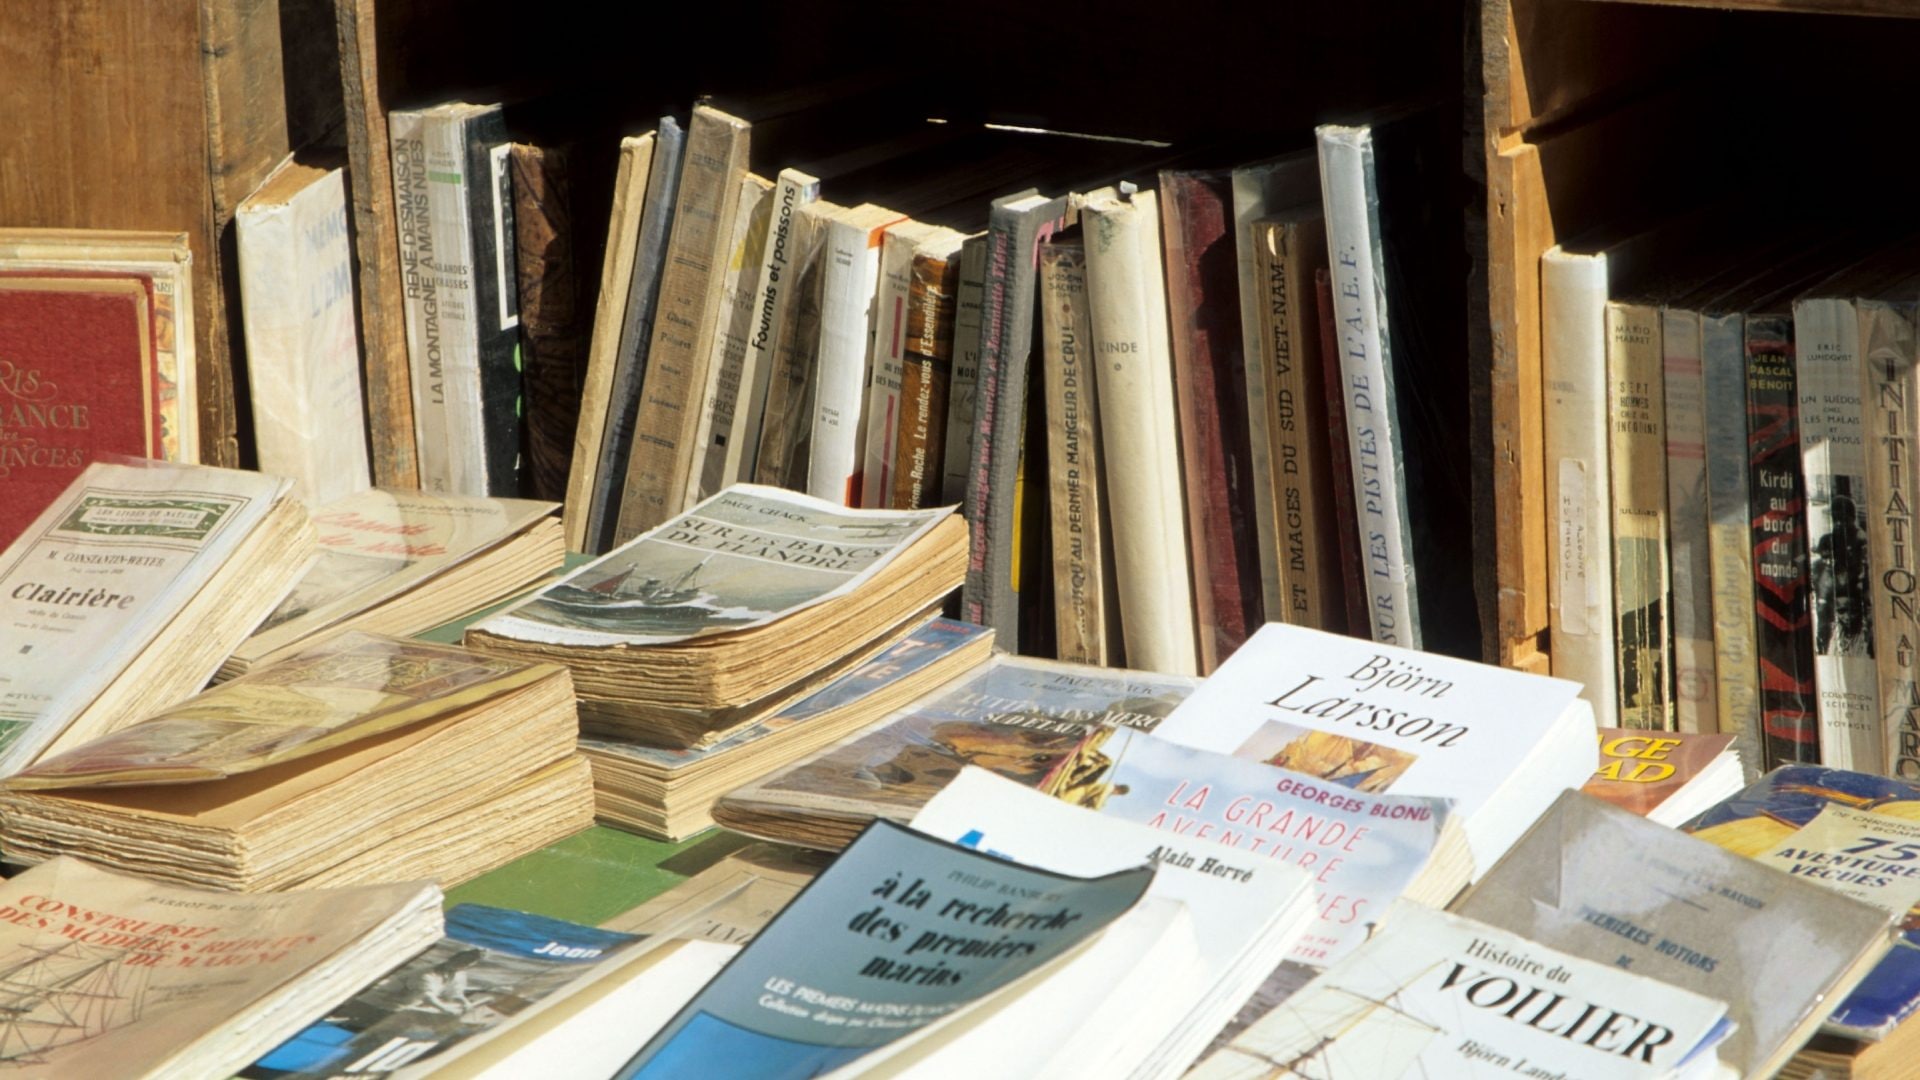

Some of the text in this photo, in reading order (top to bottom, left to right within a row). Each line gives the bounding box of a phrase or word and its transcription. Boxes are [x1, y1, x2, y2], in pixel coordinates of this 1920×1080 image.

[394, 138, 417, 247] DESMAISON
[409, 139, 444, 405] LA MONTAGNE A MAINS NUES
[434, 263, 468, 275] GRANDES
[751, 184, 796, 352] Fourmis et poissons
[435, 277, 470, 290] CHASSES
[1615, 325, 1650, 335] MARIO
[1754, 353, 1787, 364] JEAN
[1817, 343, 1842, 352] ERIC
[1063, 367, 1078, 387] DE
[1749, 365, 1794, 378] PASCAL
[1749, 378, 1794, 392] BENOIT
[917, 359, 933, 423] rendez-vous
[1352, 375, 1372, 414] DE
[1620, 382, 1650, 394] SEPT
[1800, 395, 1818, 405] UN
[0, 404, 90, 429] ANCE
[1063, 389, 1080, 465] MANGEUR
[1804, 414, 1861, 426] LES MALAIS
[914, 422, 927, 441] Le
[1269, 262, 1308, 613] ET IMAGES DU SUD VIET-NAM
[1829, 435, 1861, 446] APOUS
[1357, 426, 1384, 517] PISTES
[1759, 468, 1794, 490] Kirdi
[721, 498, 807, 524] PAUL CHACK
[1066, 470, 1084, 534] DERNIER
[1769, 496, 1787, 511] au
[677, 517, 886, 560] SUR LES BANCS
[1762, 514, 1794, 534] bord
[667, 529, 857, 571] DE FLANDRE
[1369, 531, 1390, 578] LES
[1771, 537, 1789, 555] du
[1760, 560, 1799, 579] monde
[11, 581, 136, 610] Clairière
[1376, 594, 1396, 646] SUR
[1346, 654, 1455, 700] Björn
[1821, 691, 1873, 702] COLLECTION
[1825, 702, 1871, 713] SCIENCES
[1263, 674, 1470, 749] Larsson
[1826, 720, 1872, 732] VOYAGES
[1597, 734, 1682, 761] GE
[1276, 777, 1432, 823] GEORGES BLOND
[1166, 778, 1371, 853] LA GRANDE
[1146, 844, 1256, 884] Alain Hervé
[1840, 836, 1920, 863] 75
[0, 905, 56, 930] DES
[19, 894, 221, 938] CONSTRUISEZ
[898, 876, 934, 911] la
[938, 898, 1082, 931] recherche
[847, 904, 1042, 961] des premiers
[533, 941, 602, 960] Jean
[1464, 936, 1574, 984] Histoire du
[1654, 937, 1721, 975] NOTIONS
[857, 952, 969, 988] marins
[763, 975, 795, 995] LES
[792, 984, 859, 1013] PREMIERS
[1437, 960, 1676, 1066] VOILIER
[1456, 1038, 1512, 1068] Björn
